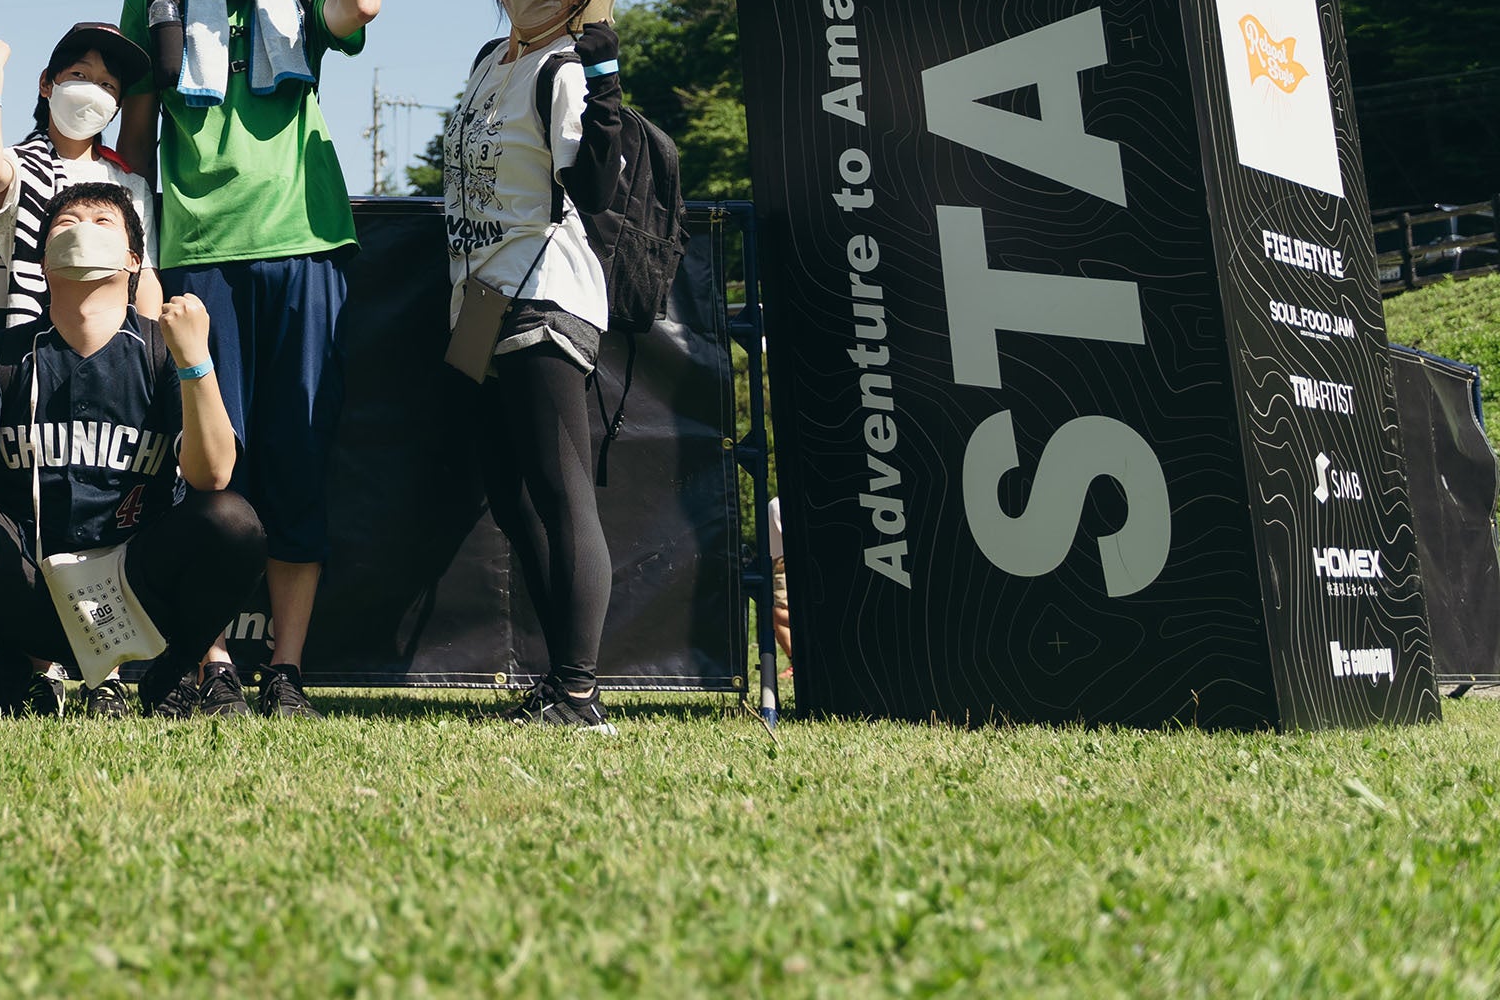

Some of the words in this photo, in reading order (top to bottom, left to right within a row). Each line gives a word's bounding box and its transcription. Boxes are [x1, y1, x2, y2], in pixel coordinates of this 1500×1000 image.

[831, 148, 874, 211] to
[1262, 230, 1344, 279] FIELDSTYLE
[1269, 300, 1301, 327] SOUL
[1300, 307, 1332, 334] FOOD
[1332, 315, 1354, 339] JAM
[842, 234, 912, 590] Adventure
[1289, 375, 1354, 415] TRIARTIST
[1331, 469, 1362, 500] SMB
[1312, 547, 1383, 578] HOMEX
